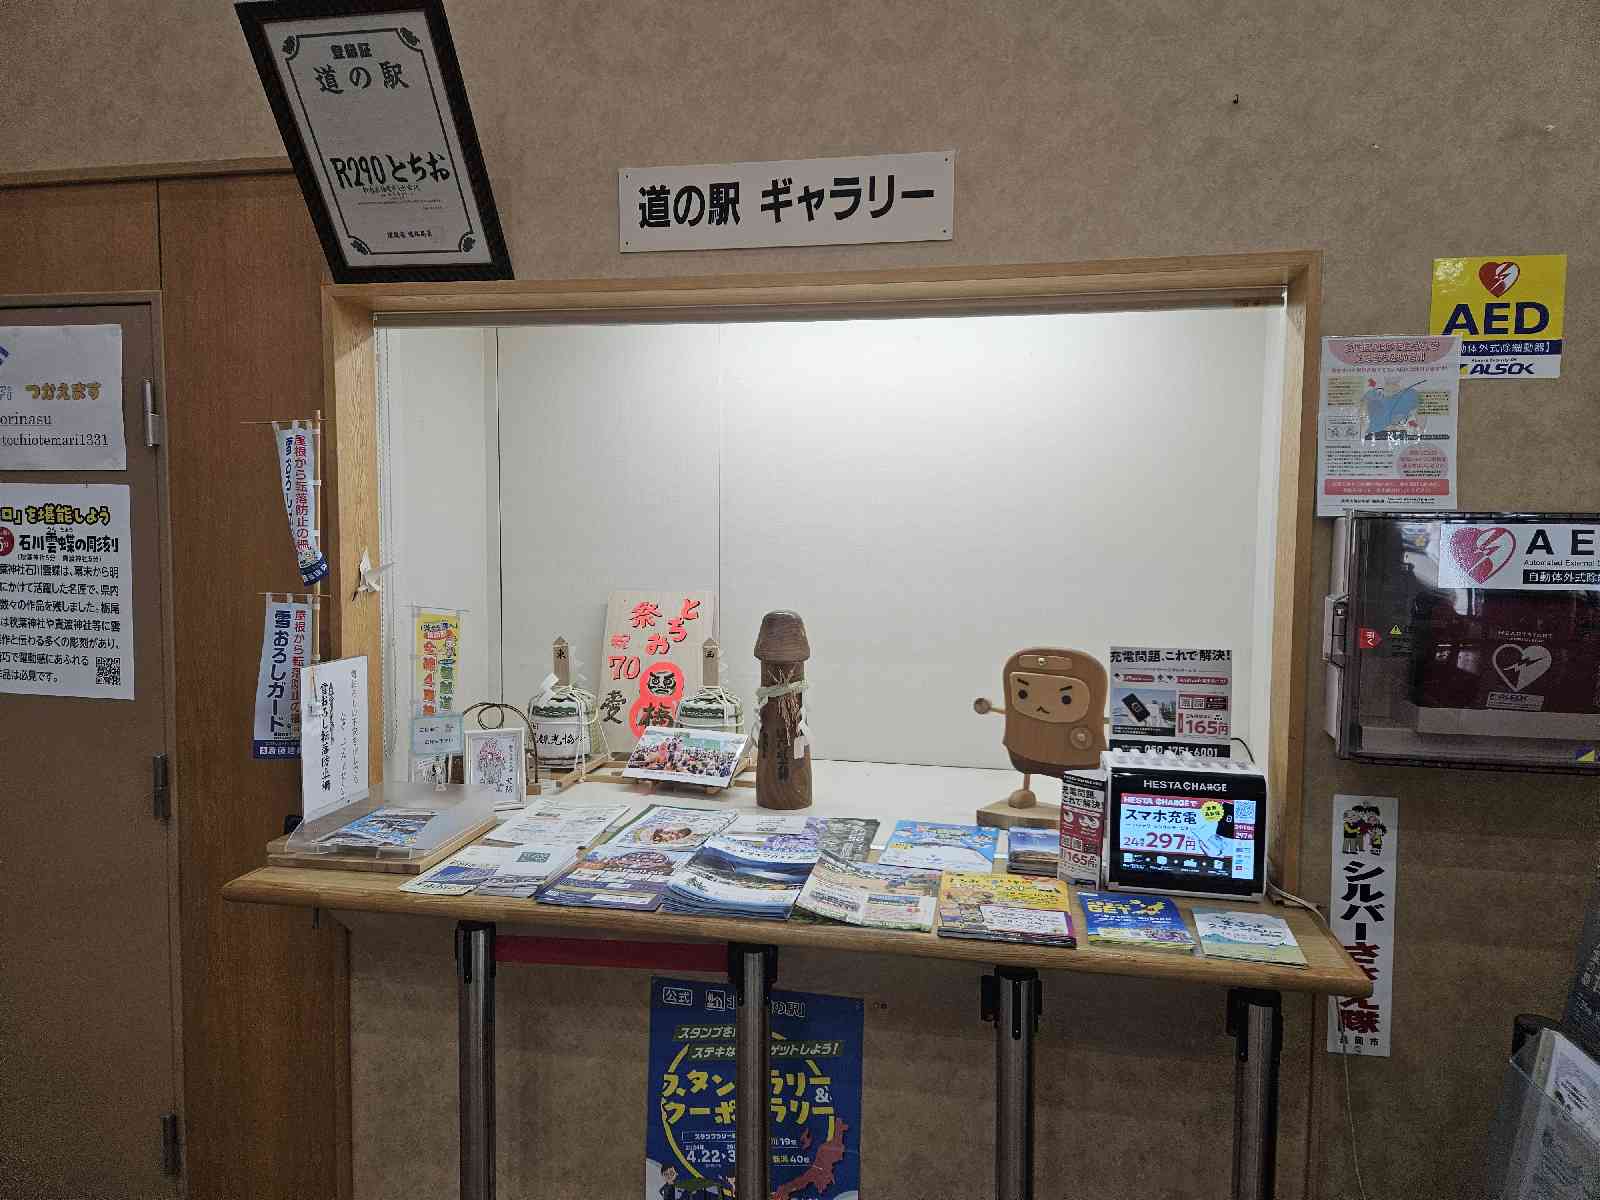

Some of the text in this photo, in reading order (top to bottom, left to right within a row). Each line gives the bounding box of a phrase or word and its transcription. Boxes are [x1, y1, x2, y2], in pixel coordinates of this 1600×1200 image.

[313, 61, 410, 94] 道の駅
[638, 173, 935, 230] 道の駅 ギャラリー
[1442, 301, 1550, 336] AED
[1470, 362, 1535, 376] ALSOK
[25, 382, 102, 401] つかえます
[19, 532, 119, 554] 石川雲蝶の彫刻
[0, 669, 58, 683] 品は必見です。
[266, 610, 292, 733] 雪おろしガード
[1186, 720, 1229, 737] 165円
[1123, 796, 1153, 805] HESTA
[1125, 808, 1197, 825] スマホ充電
[678, 1026, 736, 1040] スタンプを
